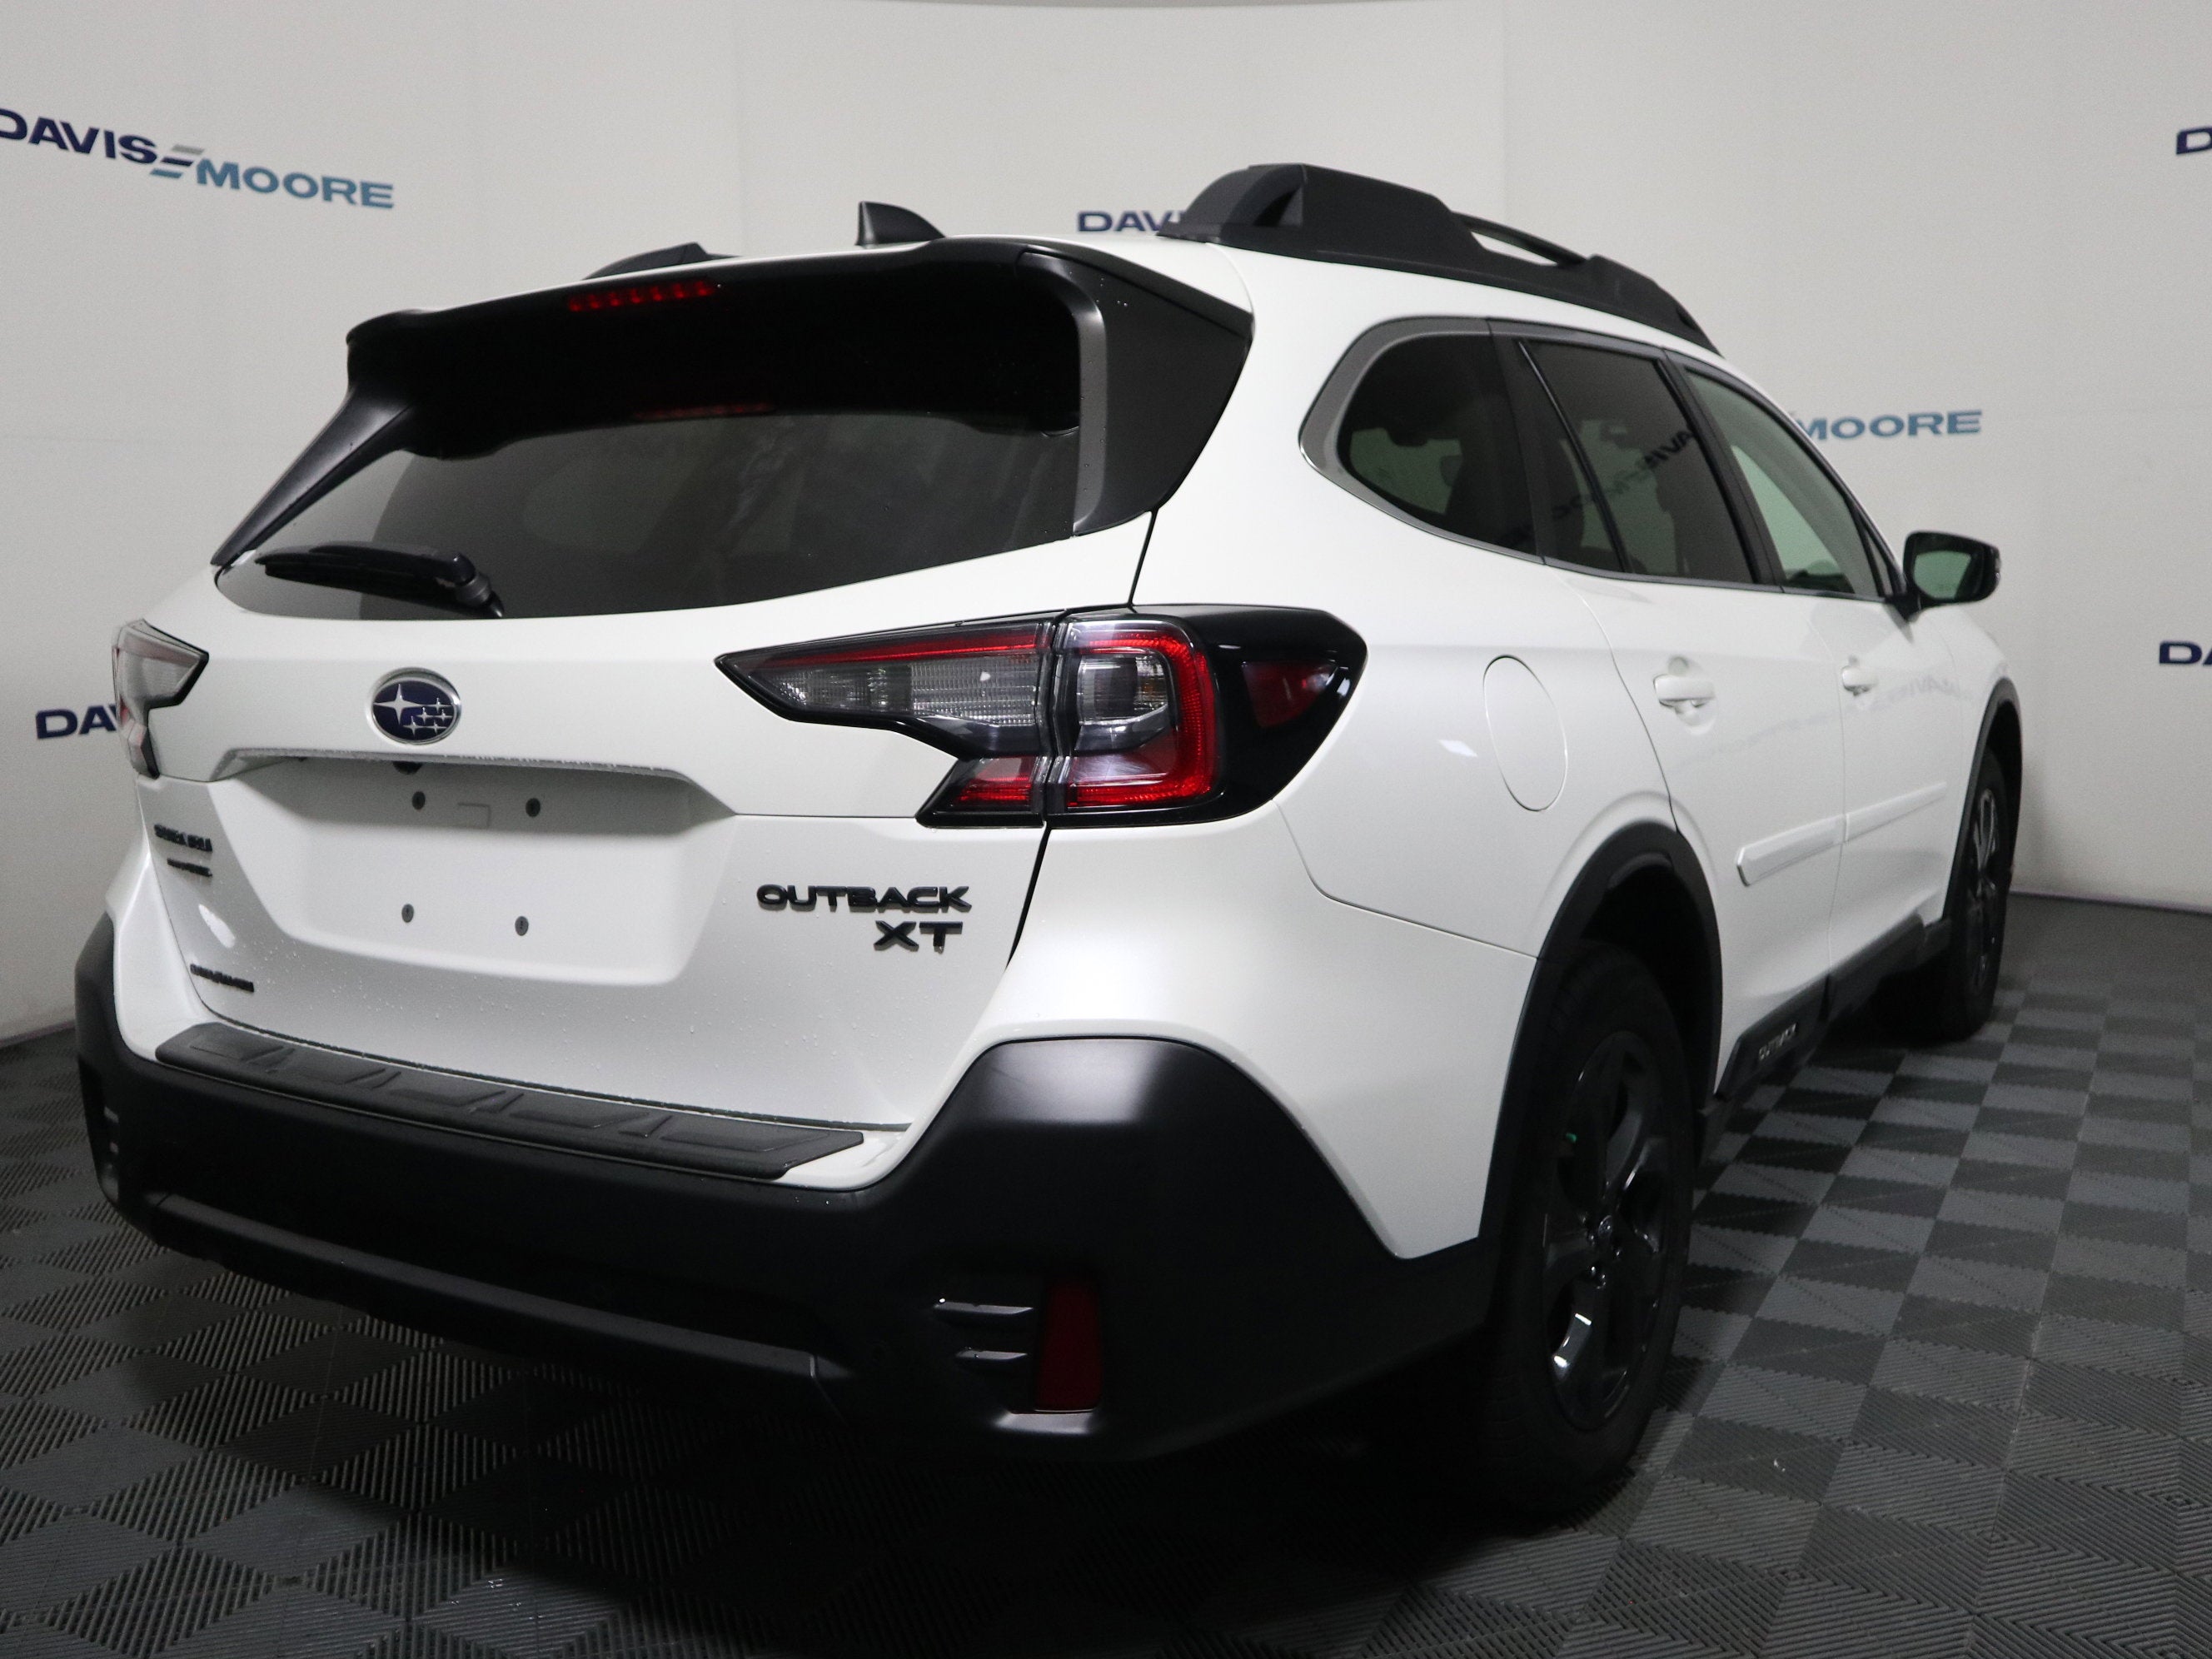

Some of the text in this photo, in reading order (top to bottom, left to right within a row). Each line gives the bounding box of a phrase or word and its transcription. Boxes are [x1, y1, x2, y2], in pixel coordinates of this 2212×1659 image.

[0, 108, 395, 209] DAVIS MOORE
[1079, 210, 1187, 232] DAV
[2159, 640, 2212, 665] D
[35, 703, 117, 740] DA
[756, 884, 972, 914] OUTBACK
[873, 920, 964, 954] XT
